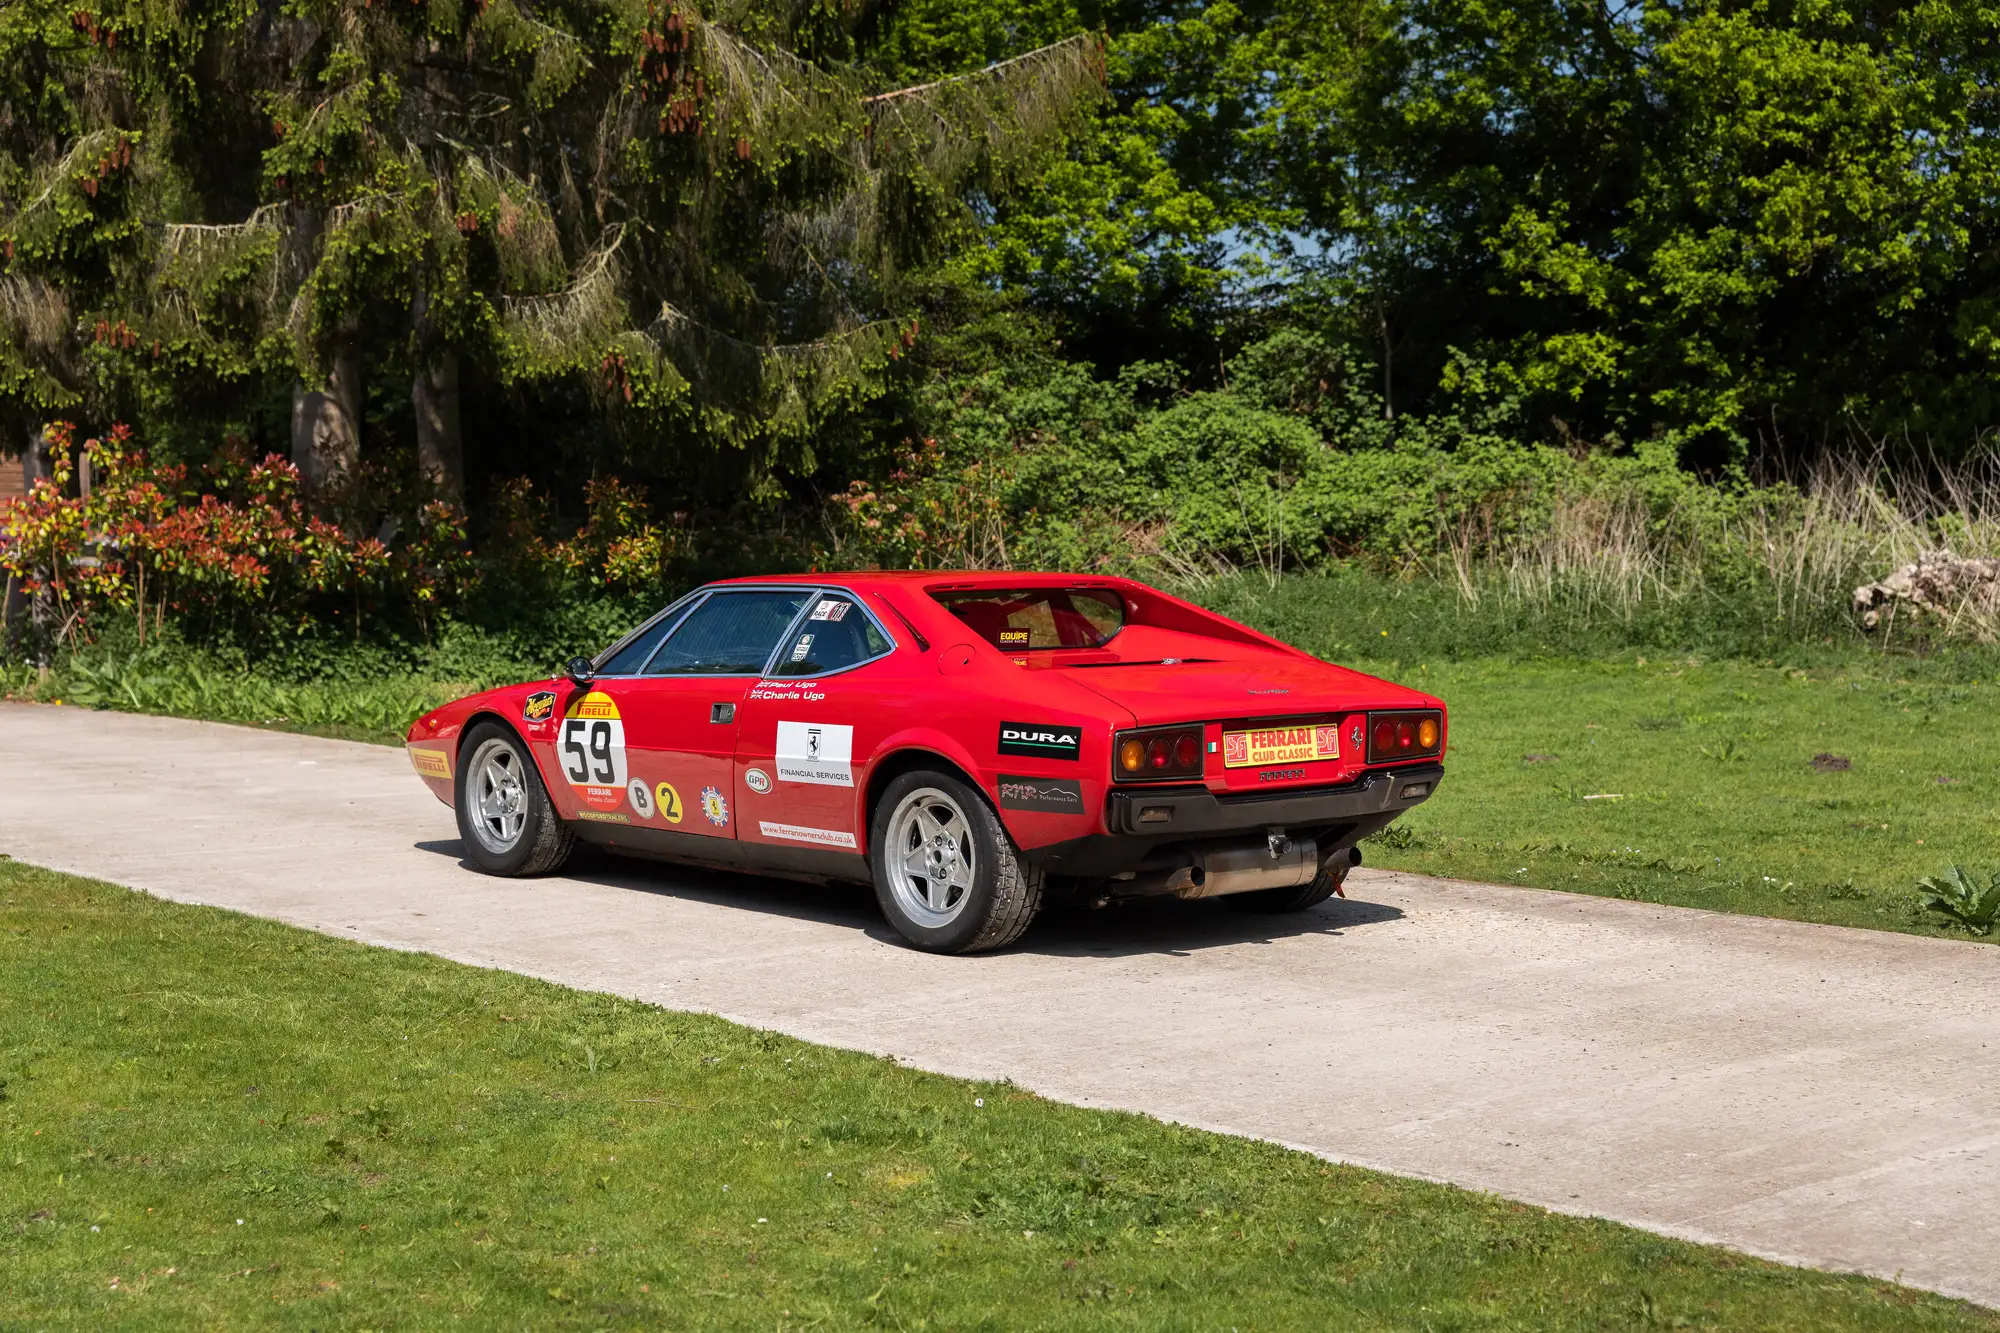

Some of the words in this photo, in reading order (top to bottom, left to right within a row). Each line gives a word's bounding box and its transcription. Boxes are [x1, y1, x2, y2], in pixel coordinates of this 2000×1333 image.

[763, 691, 800, 700] Charlie
[803, 691, 825, 701] Ugo
[577, 702, 612, 716] PIRELLI
[1003, 730, 1076, 745] DURA
[1251, 728, 1312, 749] FERRARI
[565, 721, 615, 784] 59
[1252, 750, 1275, 762] CLUB
[1277, 747, 1313, 760] CLASSIC
[415, 755, 446, 773] PIRELLI
[749, 775, 765, 787] GPR
[780, 769, 815, 778] FINANCIAL
[816, 771, 850, 781] SERVICES
[587, 788, 612, 797] FERRARI
[634, 787, 648, 808] B
[661, 787, 680, 817] 2
[762, 826, 854, 845] www.ferrariownersclub.co.uk
